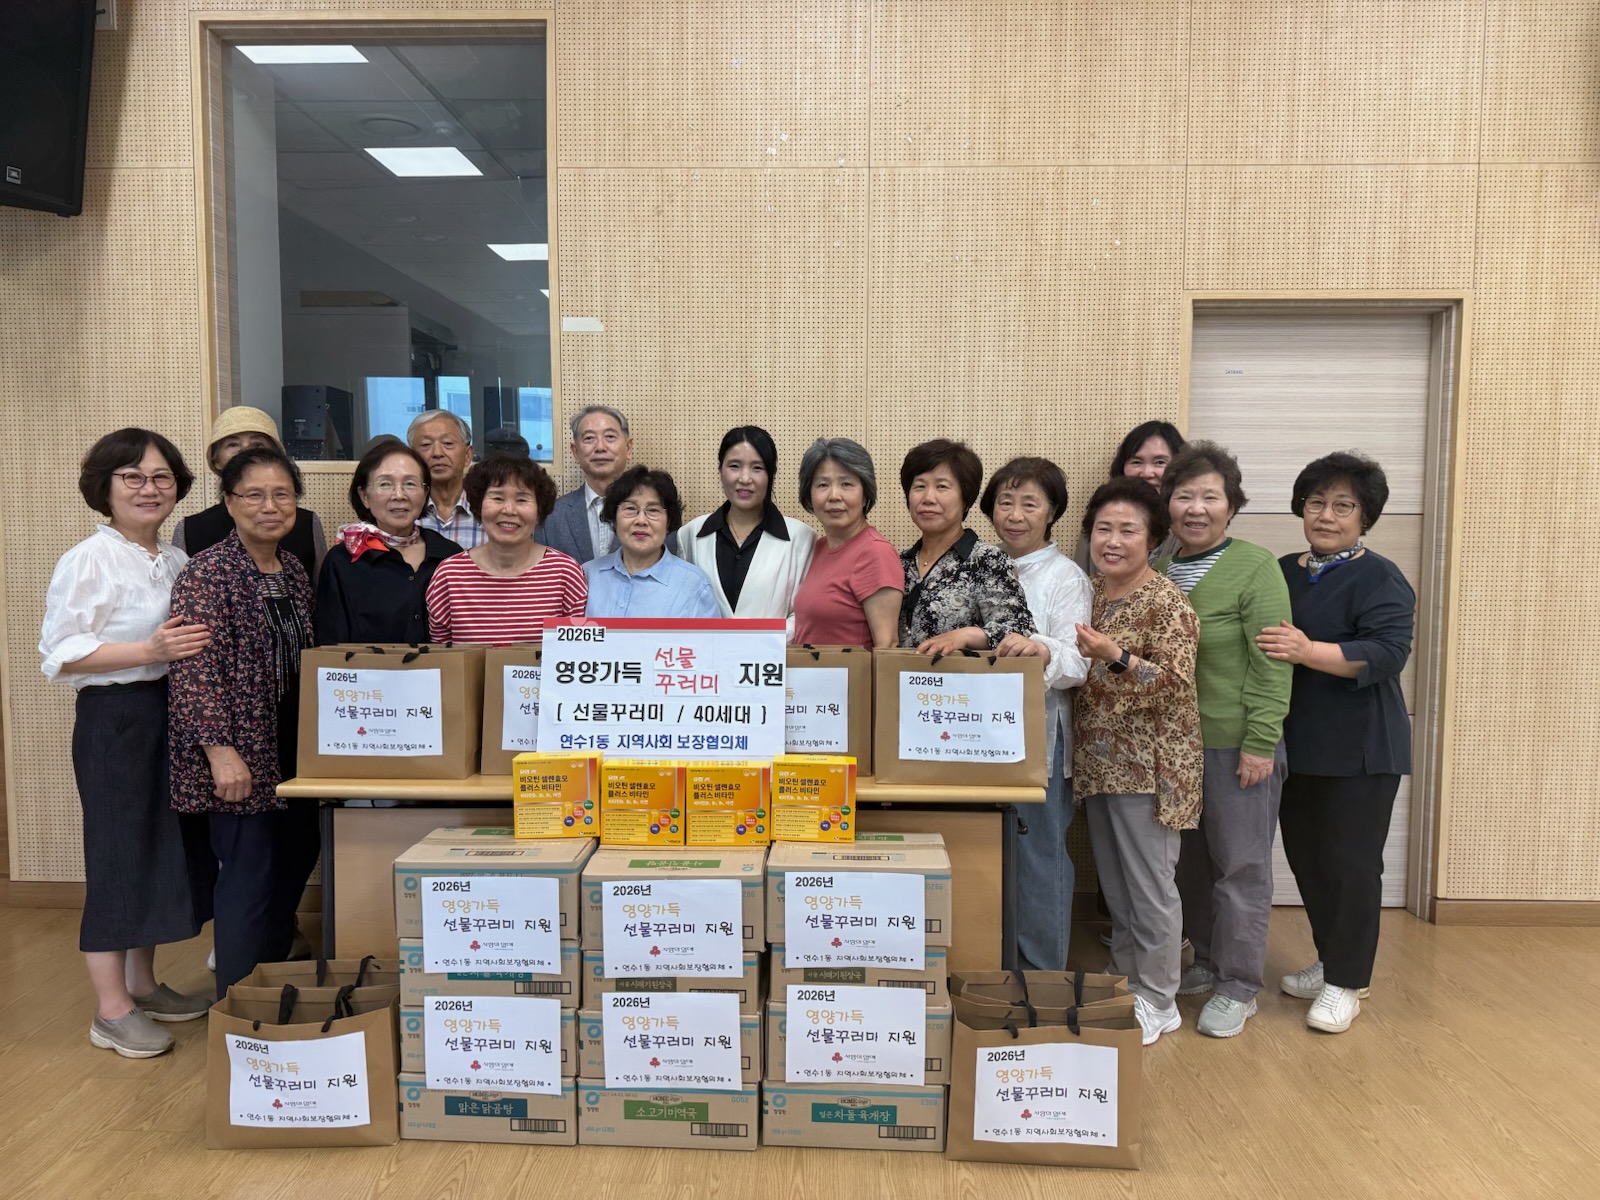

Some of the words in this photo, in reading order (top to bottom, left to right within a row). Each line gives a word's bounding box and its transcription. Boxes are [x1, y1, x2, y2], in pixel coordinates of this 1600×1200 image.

[557, 628, 604, 642] 2026년
[655, 647, 696, 669] 선물
[326, 672, 358, 683] 2026년
[556, 661, 642, 684] 영양가득
[739, 663, 783, 686] 지원
[655, 674, 718, 694] 꾸러미
[910, 676, 943, 687] 2026년
[334, 689, 384, 702] 영양가득
[917, 692, 970, 707] 영양가득
[335, 705, 397, 719] 선물꾸러미
[406, 706, 433, 718] 지원
[573, 704, 663, 722] 선물꾸러미
[694, 705, 750, 724] 40세대
[816, 703, 840, 716] 지원
[918, 709, 982, 724] 선물꾸러미
[992, 711, 1016, 724] 지원
[362, 742, 425, 750] 지역사회보장협의체
[517, 738, 538, 746] 연수1
[560, 734, 610, 749] 연수1동
[617, 734, 672, 749] 지역사회
[677, 735, 748, 750] 보장협의체
[945, 748, 1008, 757] 지역사회보장협의체
[608, 782, 628, 790] 비오틴
[779, 778, 798, 786] 비오틴
[608, 790, 628, 798] 플러스
[630, 790, 649, 798] 비타민
[779, 786, 798, 794] 플러스
[800, 786, 820, 794] 비타민
[432, 881, 470, 892] 2026년
[796, 876, 833, 888] 2026년
[613, 884, 651, 896] 2026년
[442, 899, 500, 914] 영양가득
[804, 896, 862, 910] 영양가득
[622, 903, 680, 918] 영양가득
[444, 917, 514, 932] 선물꾸러미
[524, 919, 552, 933] 지원
[806, 914, 876, 929] 선물꾸러미
[888, 915, 916, 930] 지원
[624, 922, 694, 938] 선물꾸러미
[706, 922, 734, 936] 지원
[476, 958, 544, 967] 지역사회보장협의체
[804, 954, 832, 962] 연수1동
[836, 955, 906, 963] 지역사회보장협의체
[622, 964, 650, 972] 연수1동
[656, 964, 725, 972] 지역사회보장협의체
[612, 997, 650, 1008] 2026년
[797, 990, 835, 1002] 2026년
[435, 1000, 472, 1012] 2026년
[622, 1016, 679, 1030] 영양가득
[806, 1010, 864, 1024] 영양가득
[444, 1019, 501, 1033] 영양가득
[624, 1034, 694, 1049] 선물꾸러미
[704, 1035, 732, 1049] 지원
[806, 1028, 878, 1044] 선물꾸러미
[888, 1030, 916, 1045] 지원
[236, 1040, 269, 1054] 2026년
[445, 1036, 515, 1052] 선물꾸러미
[526, 1040, 552, 1054] 지원
[987, 1050, 1025, 1062] 2026년
[246, 1056, 300, 1076] 영양가득
[623, 1074, 651, 1082] 연수1동
[656, 1075, 724, 1083] 지역사회보장협의체
[837, 1070, 906, 1078] 지역사회보장협의체
[996, 1066, 1054, 1084] 영양가득
[249, 1074, 316, 1091] 선물꾸러미
[328, 1074, 358, 1088] 지원
[476, 1078, 544, 1087] 지역사회보장협의체
[996, 1086, 1068, 1102] 선물꾸러미
[1078, 1088, 1108, 1104] 지원
[458, 1102, 480, 1114] 맑은
[481, 1103, 514, 1114] 닭곰탕
[636, 1106, 697, 1120] 소고기미역국
[247, 1114, 274, 1122] 연수1동
[279, 1114, 350, 1122] 지역사회보장협의체
[992, 1128, 1021, 1136] 연수1동
[1026, 1128, 1098, 1138] 지역사회보장협의체
